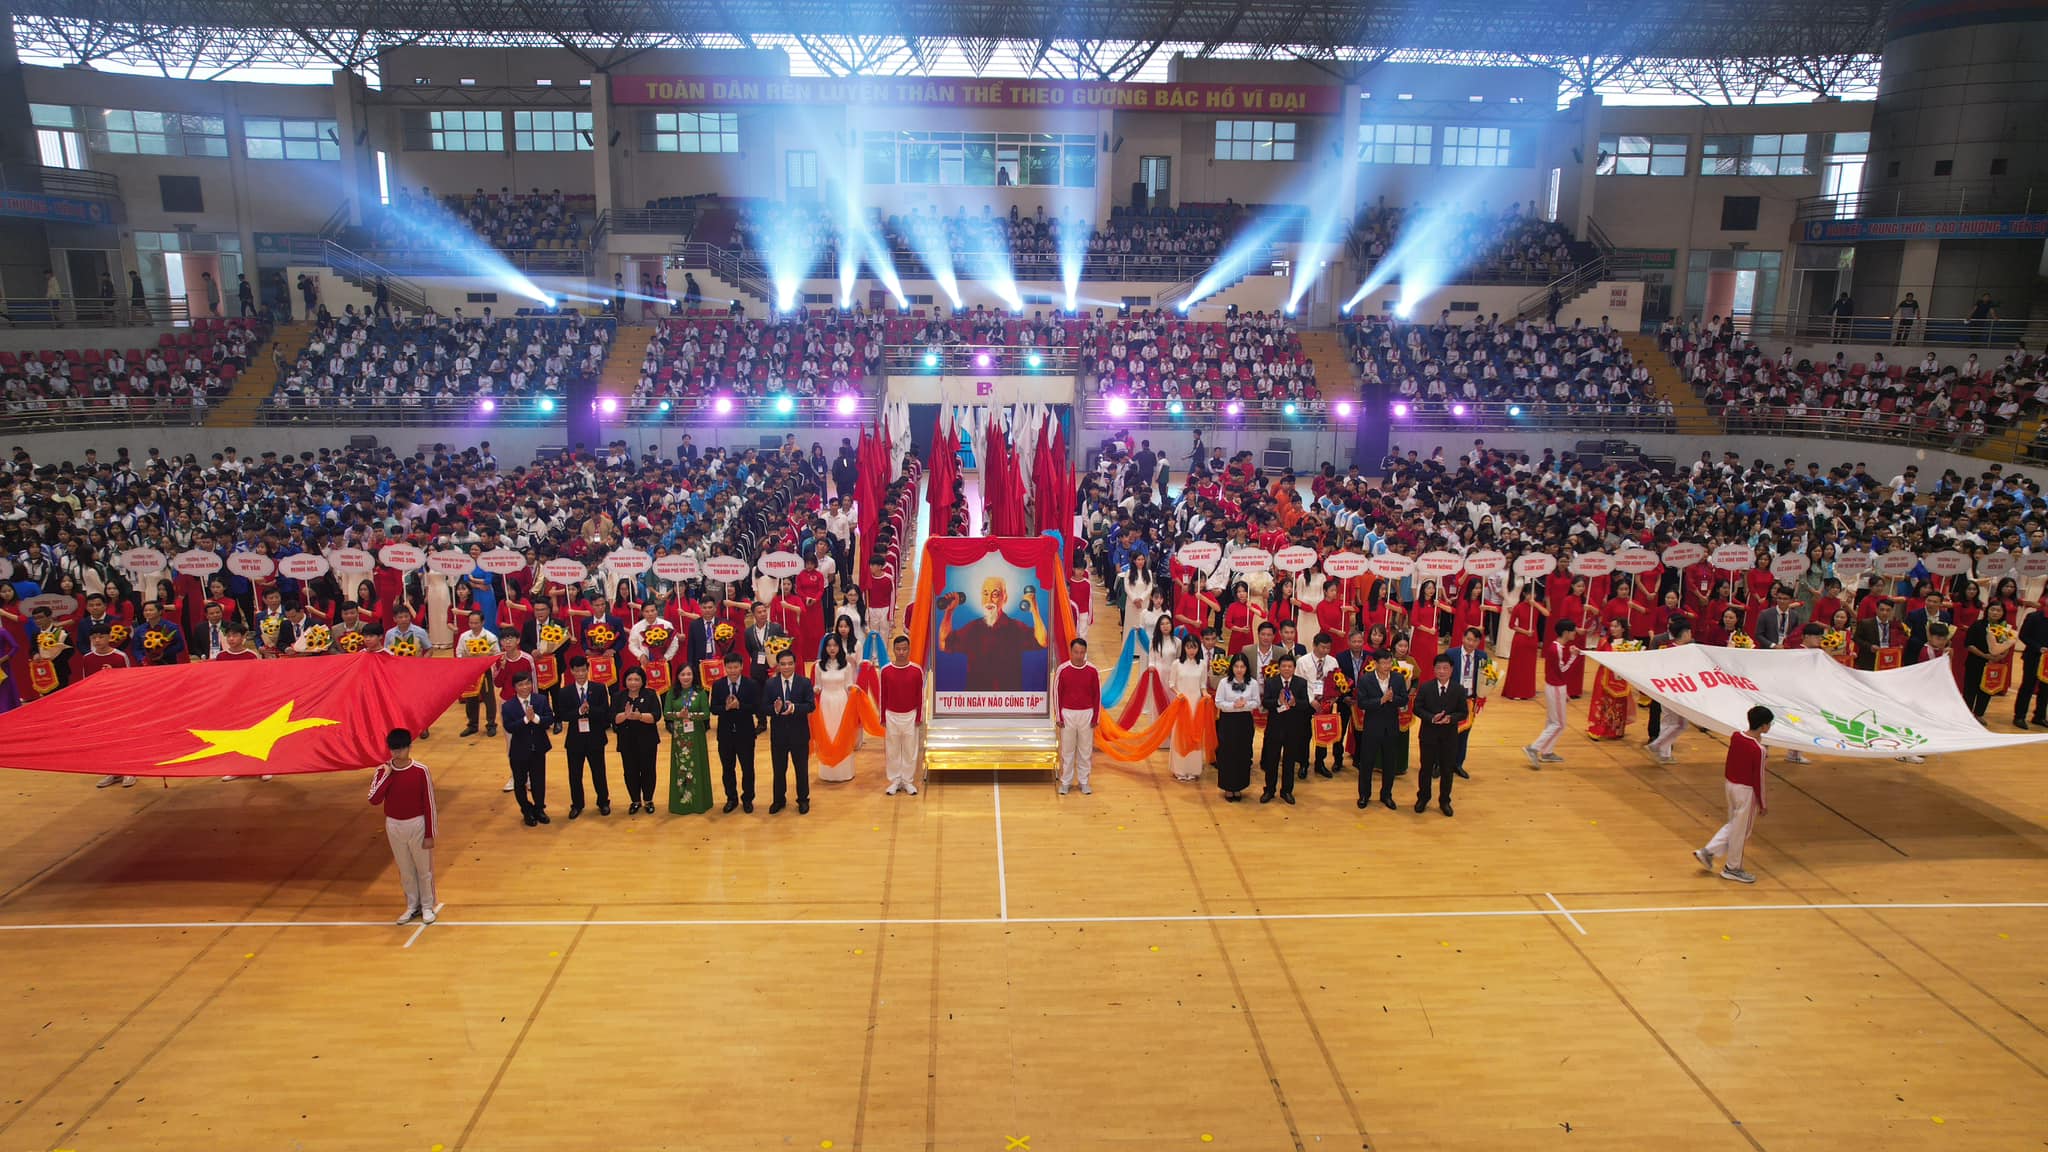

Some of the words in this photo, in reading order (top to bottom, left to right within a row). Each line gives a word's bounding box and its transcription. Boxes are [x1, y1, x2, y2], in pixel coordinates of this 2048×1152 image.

[646, 79, 704, 99] TOÀN
[713, 79, 761, 99] DÂN
[896, 81, 955, 102] THÂN
[961, 80, 1003, 103] THỂ
[1009, 87, 1064, 104] THEO
[1073, 86, 1148, 106] GƯƠNG
[1156, 86, 1199, 108] BÁC
[1206, 85, 1235, 109] HỒ
[1242, 87, 1263, 109] VĨ
[1269, 91, 1306, 113] ĐẠI
[1650, 672, 1698, 692] PHÙ
[954, 695, 965, 708] TÔI
[967, 694, 986, 707] NGÀY
[988, 695, 1003, 707] NÀO
[1004, 694, 1025, 708] CŨNG
